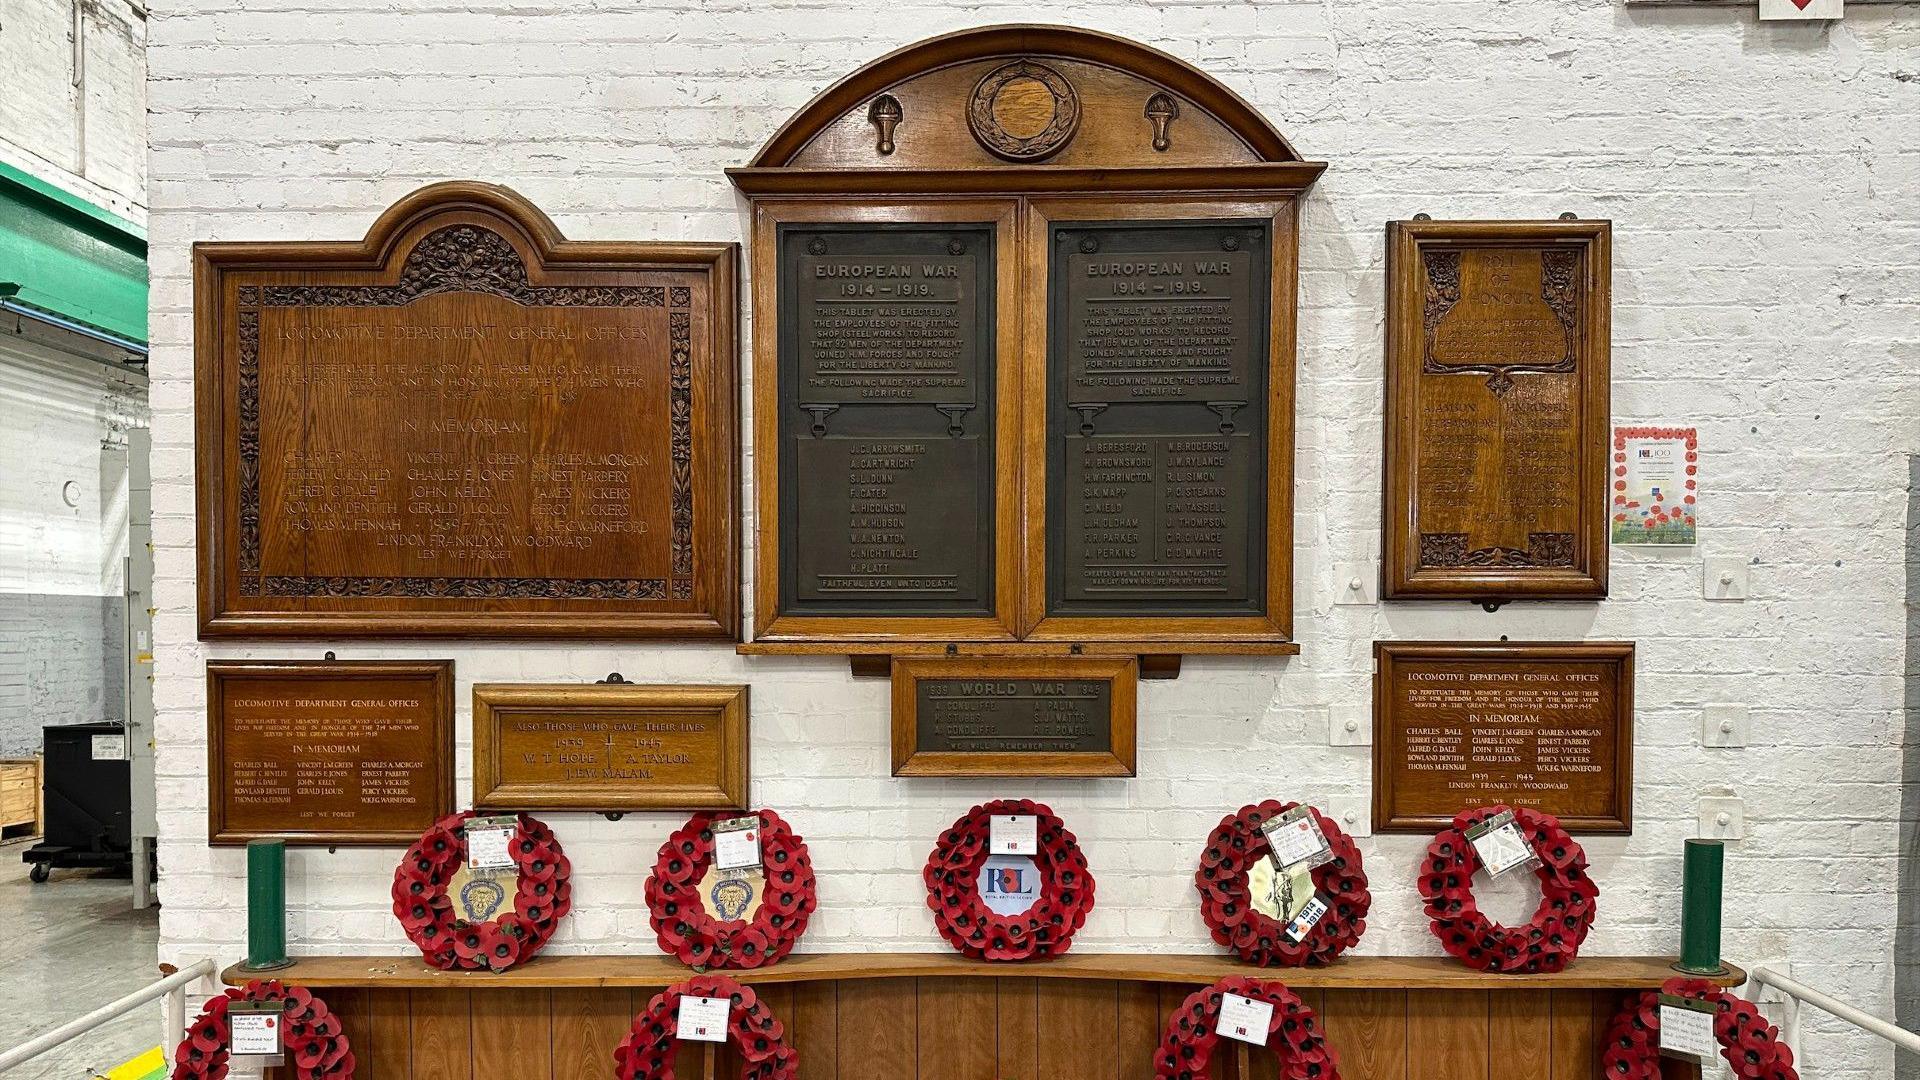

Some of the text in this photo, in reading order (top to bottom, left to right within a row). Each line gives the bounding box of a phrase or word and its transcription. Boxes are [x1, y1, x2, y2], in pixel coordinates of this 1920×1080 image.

[816, 265, 958, 278] EUROPEAN WAR
[1088, 262, 1231, 276] EUROPEAN WAR
[816, 308, 957, 316] THIS TABLET WAS ERECTED BY
[1088, 306, 1230, 316] THIS TABLET WAS ERECTED BY
[814, 320, 960, 328] THE EMPLOYEES OF THE FITTING
[1105, 318, 1157, 326] EMPLOYEES
[1161, 318, 1173, 326] OF
[1197, 317, 1233, 325] FITTING
[278, 326, 648, 340] LOCOMOTIVE DEPARTMENT GENERAL OFFICES
[816, 330, 840, 338] SHOP
[908, 330, 920, 338] TO
[922, 330, 956, 338] RECORD
[1087, 328, 1111, 336] SHOP
[1177, 327, 1189, 335] TO
[1193, 327, 1230, 335] RECORD
[905, 341, 964, 349] DEPARTMENT
[1080, 339, 1101, 347] THAT
[1143, 338, 1154, 346] OF
[1158, 338, 1175, 346] THE
[1178, 337, 1237, 346] DEPARTMENT
[815, 350, 960, 359] JOINED FORCES AND FOUGHT
[1084, 347, 1232, 357] JOINED FORCES AND FOUGHT
[819, 361, 836, 369] FOR
[1086, 360, 1103, 368] FOR
[1127, 359, 1166, 367] LIBERTY
[1170, 359, 1181, 367] OF
[829, 379, 967, 387] FOLLOWING MADE SUPREME
[1097, 376, 1240, 386] FOLLOWING MADE SUPREME
[401, 417, 527, 433] IN MEMORIAM
[1097, 443, 1148, 452] BERESFORD
[407, 469, 460, 481] CHARLES
[531, 470, 573, 482] ERNEST
[409, 486, 492, 499] JOHN KELLY
[581, 487, 630, 500] VICKERS
[409, 502, 511, 514] GERALD LOUIS
[1180, 518, 1226, 527] THOMPSON
[378, 534, 592, 548] LINDON FRANKLYN WOODWARD
[471, 550, 512, 559] FORGET
[1097, 549, 1136, 558] PERKINS
[1408, 673, 1464, 681] LOCOMOTIVE
[1469, 673, 1519, 681] DEPARTMENT
[1565, 674, 1599, 682] OFFICES
[961, 683, 1065, 695] WORLD WAR
[1469, 714, 1540, 723] IN MEMORIAM
[514, 723, 705, 731] ALSO THOSE WHO GAVE THEIR LIVES
[555, 737, 663, 749] 1939 1945
[293, 745, 360, 753] IN MEMORIAM
[1299, 902, 1317, 920] 1914
[1306, 907, 1324, 925] 1918
